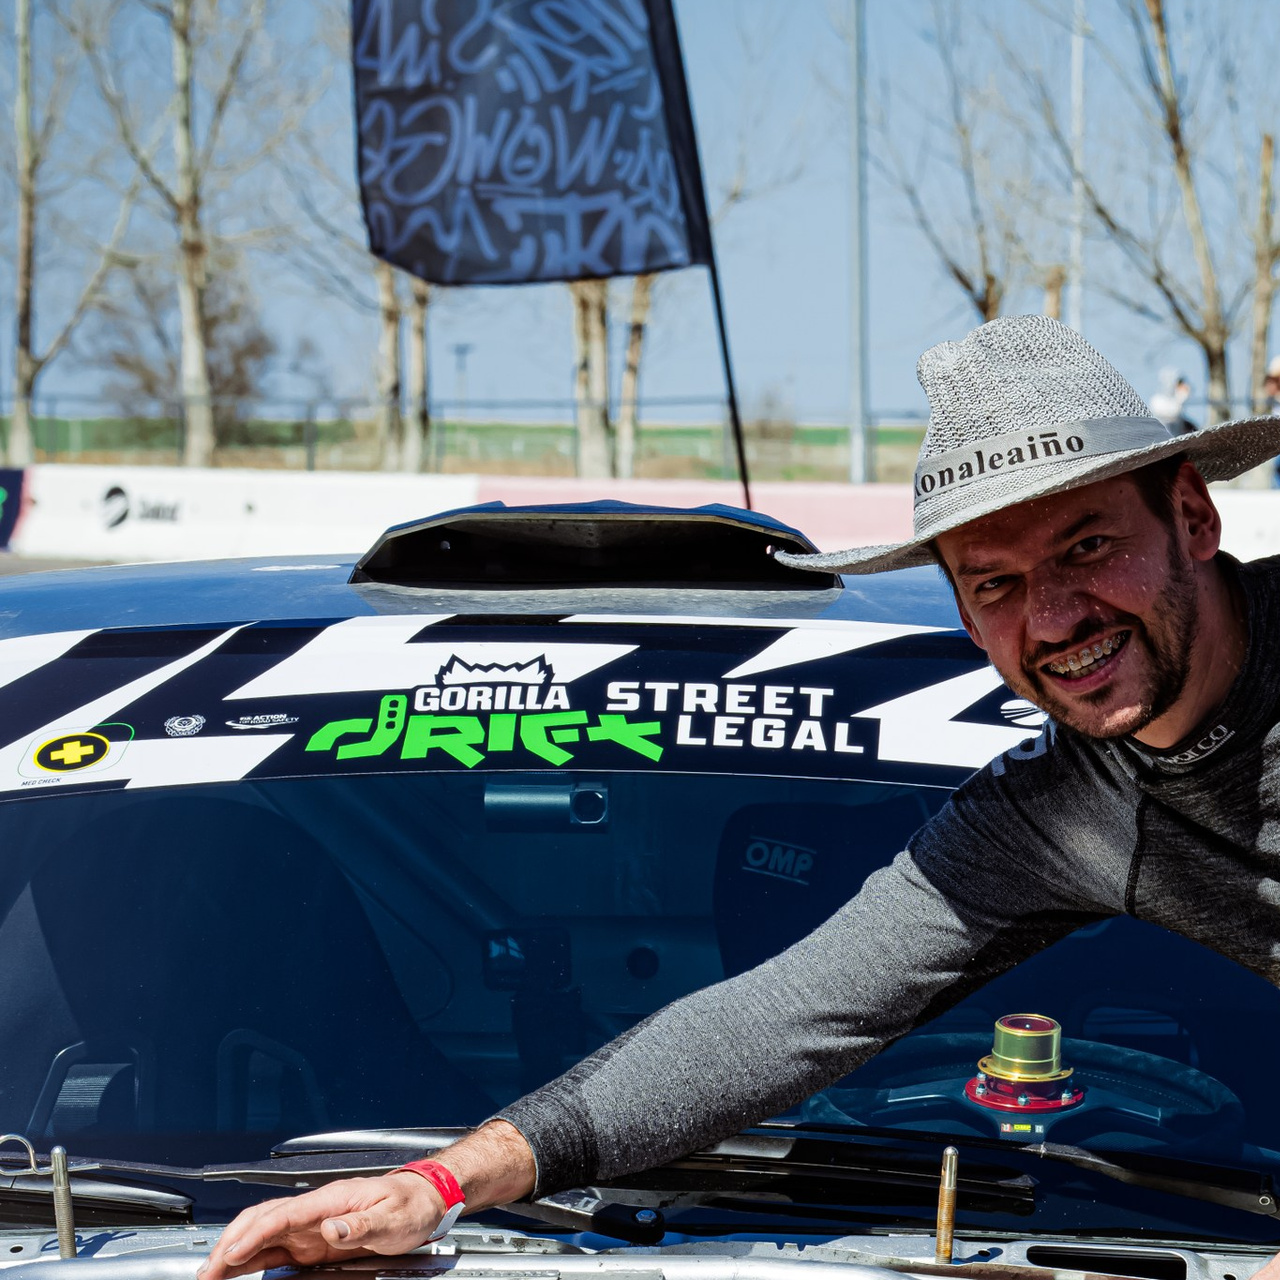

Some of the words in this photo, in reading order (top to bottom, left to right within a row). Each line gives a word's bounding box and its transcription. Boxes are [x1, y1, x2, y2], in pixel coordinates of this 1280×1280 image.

[414, 685, 570, 711] GORILLA
[606, 681, 834, 717] STREET
[676, 715, 864, 753] LEGAL
[1158, 724, 1228, 763] arco
[746, 842, 813, 877] OMP
